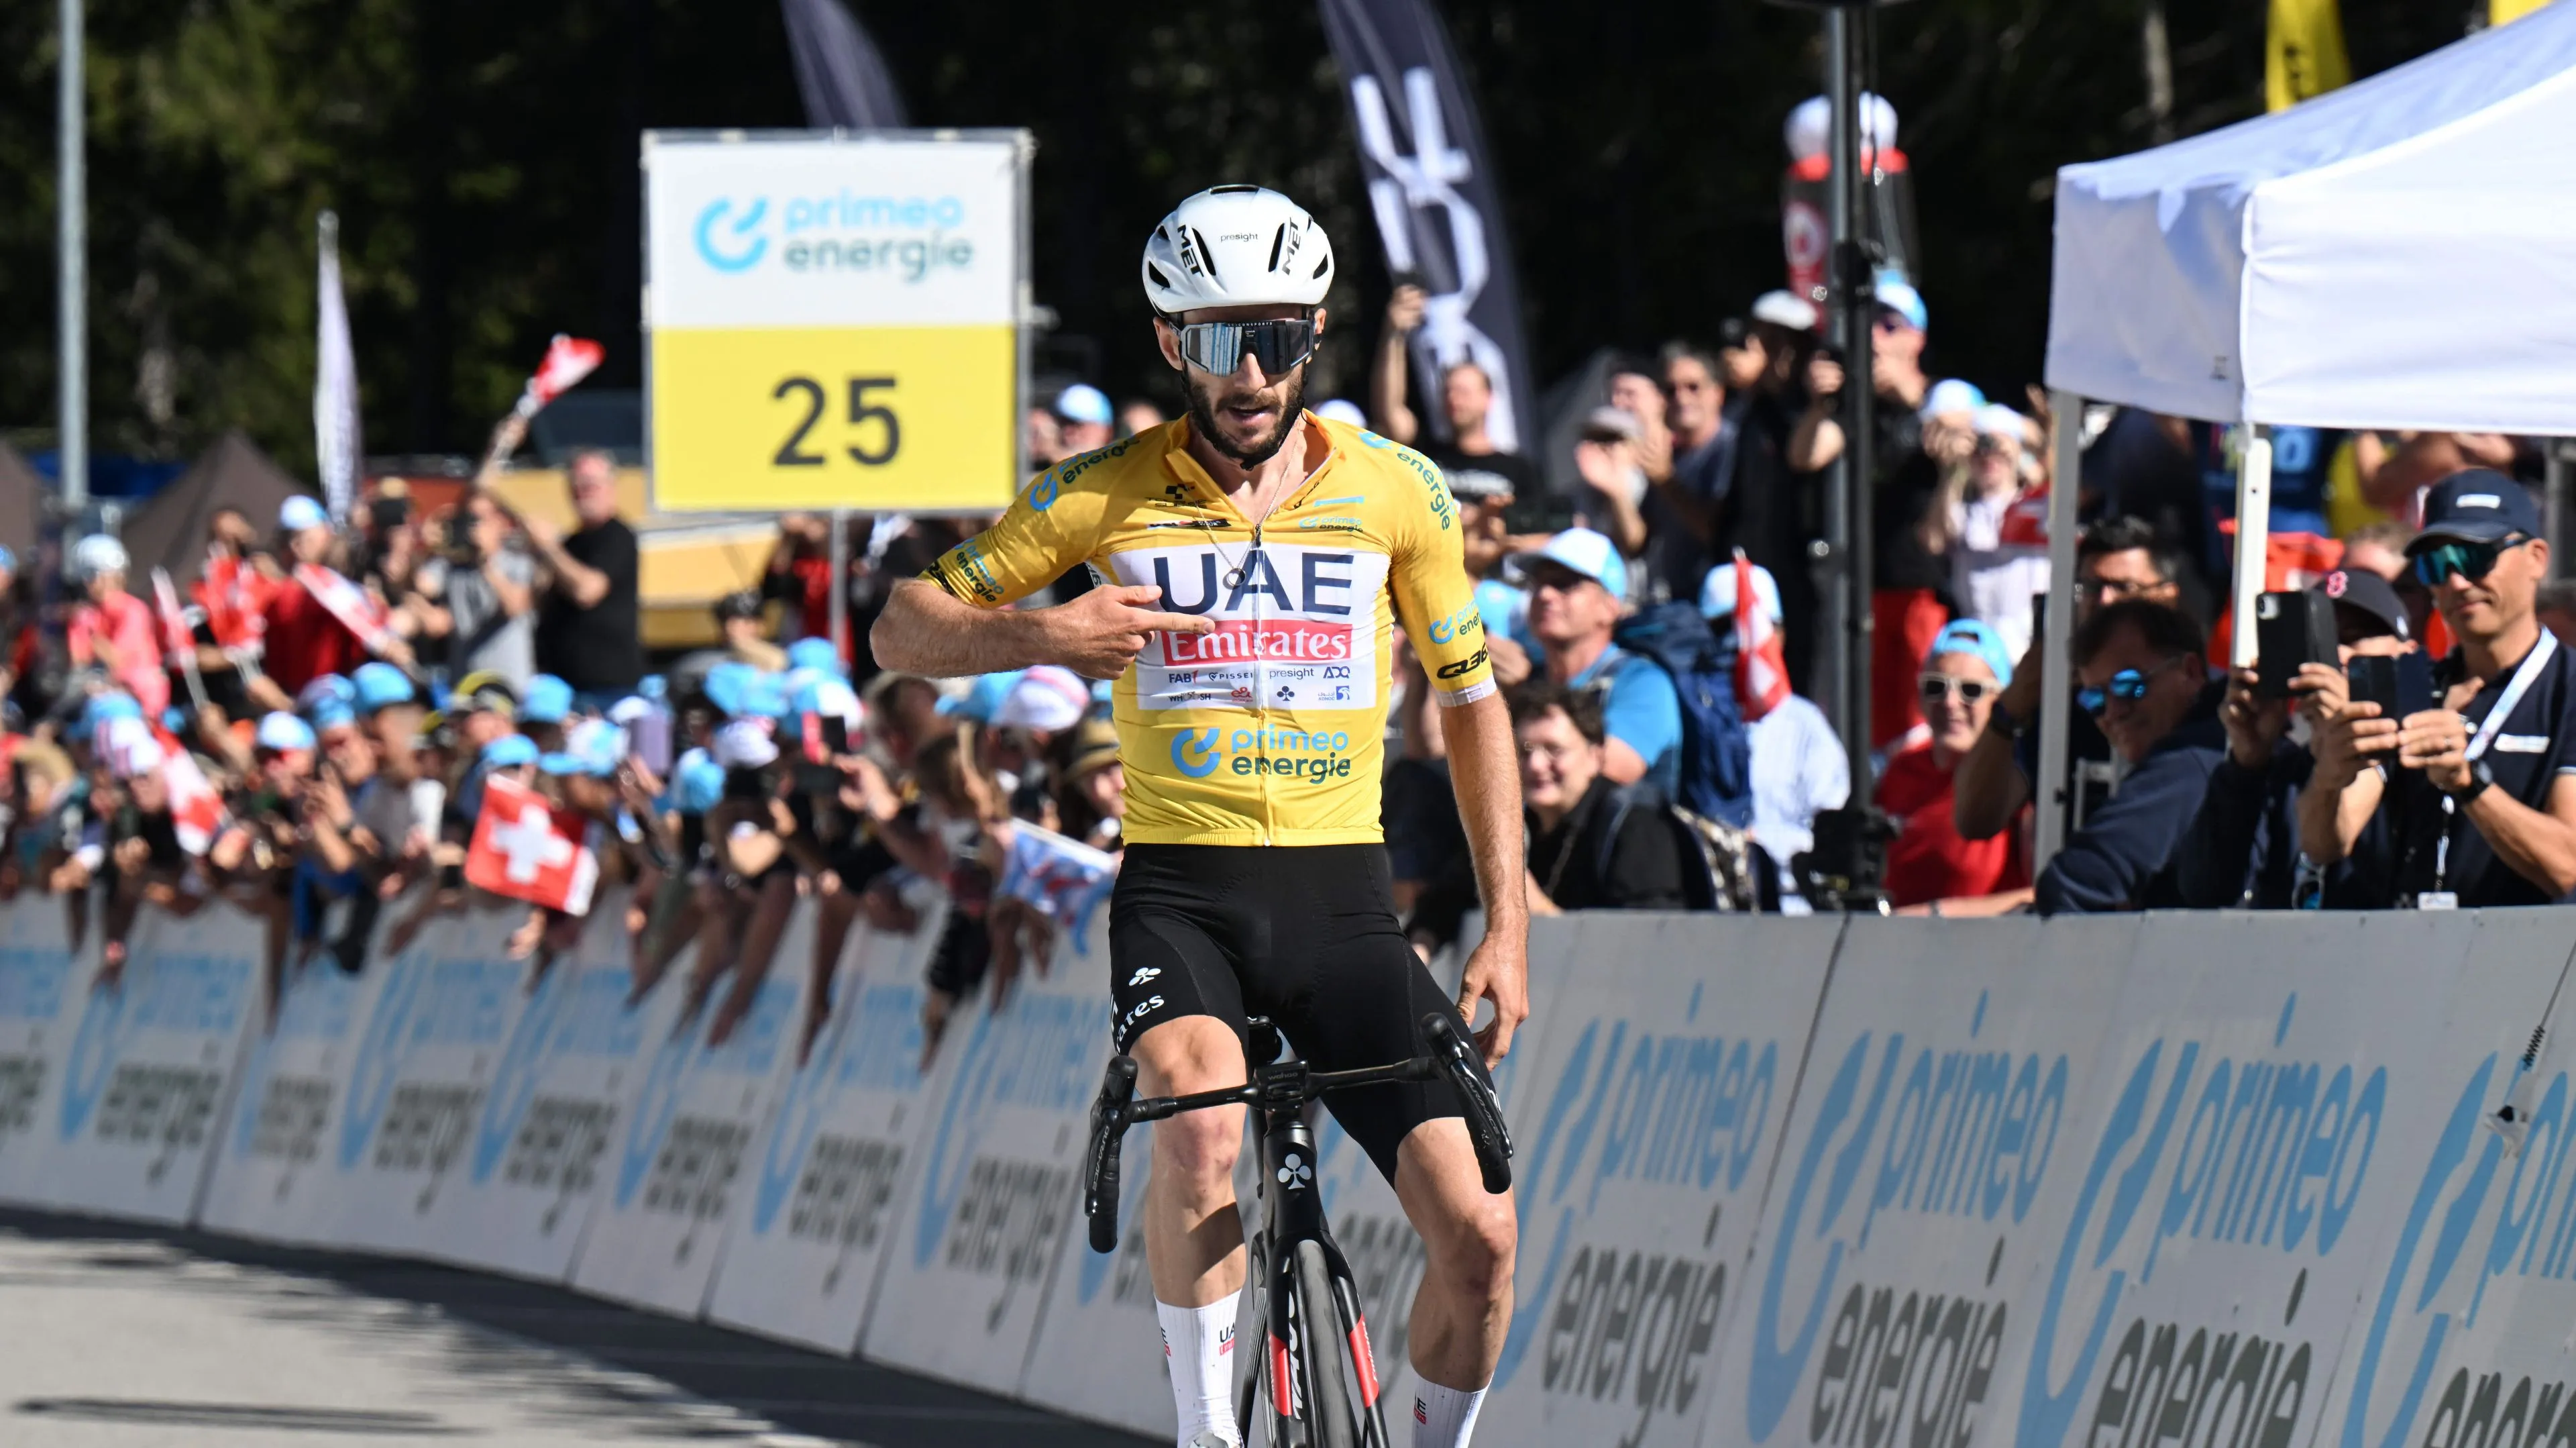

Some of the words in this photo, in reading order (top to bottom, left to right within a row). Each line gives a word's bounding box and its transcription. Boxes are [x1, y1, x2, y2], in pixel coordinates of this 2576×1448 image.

[784, 190, 965, 234] primeo
[783, 234, 974, 282] energie
[1177, 223, 1205, 278] MET
[1220, 233, 1258, 243] presight
[1282, 217, 1301, 276] MET
[771, 374, 903, 467] 25
[1397, 452, 1450, 531] energie
[1153, 550, 1354, 615] UAE
[1170, 625, 1347, 661] Emirates
[1169, 673, 1192, 684] FAB
[1269, 668, 1315, 680] presight
[1323, 666, 1351, 679] ADQ
[1232, 724, 1348, 754] primeo
[1232, 752, 1350, 784] energie
[1858, 988, 2069, 1250] primeo
[2140, 991, 2387, 1284] primeo
[1809, 1234, 2007, 1448] energie
